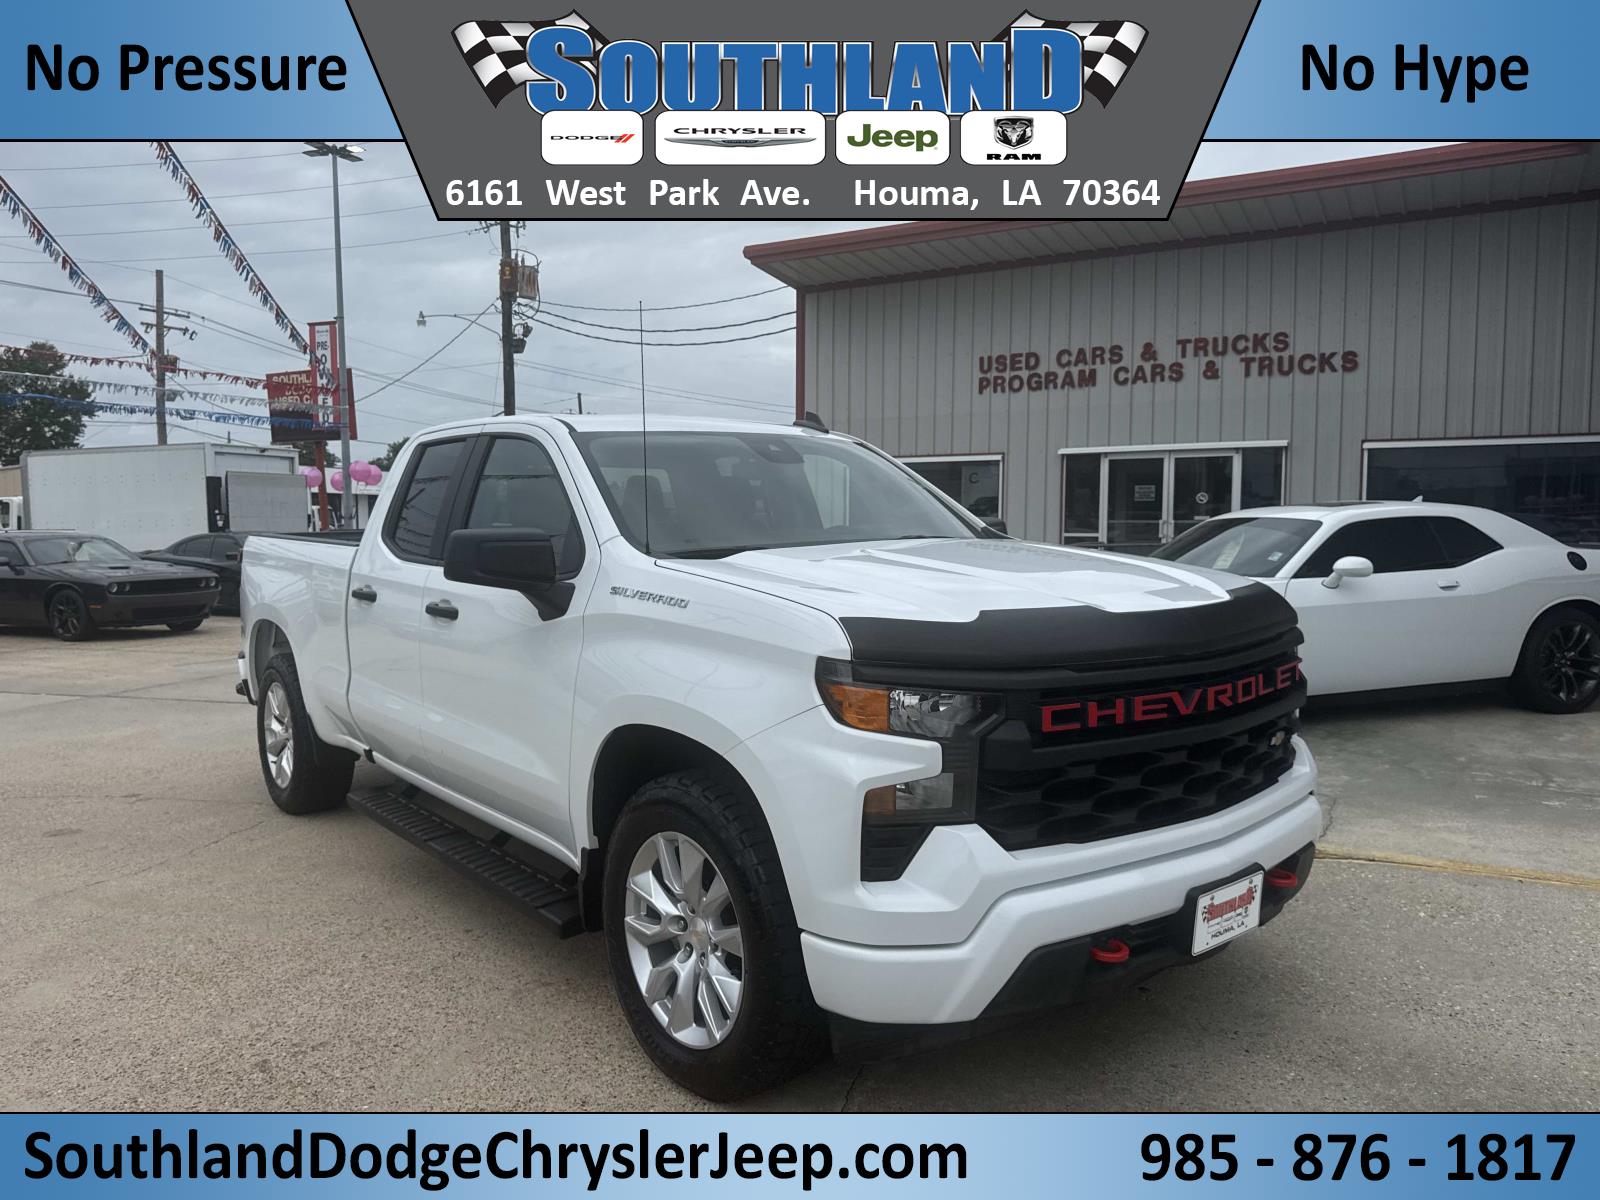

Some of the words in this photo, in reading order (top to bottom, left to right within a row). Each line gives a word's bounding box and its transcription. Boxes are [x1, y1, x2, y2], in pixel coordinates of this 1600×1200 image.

[978, 368, 1097, 395] PROGRAM
[1113, 362, 1184, 386] CARS
[1202, 360, 1220, 380] &
[1240, 350, 1359, 378] TRUCKS
[979, 352, 1040, 375] USED
[1056, 344, 1123, 369] CARS
[1140, 342, 1158, 362] &
[1176, 332, 1290, 359] TRUCKS
[609, 586, 691, 609] SILVERADO
[1040, 659, 1302, 733] CHEVROLET
